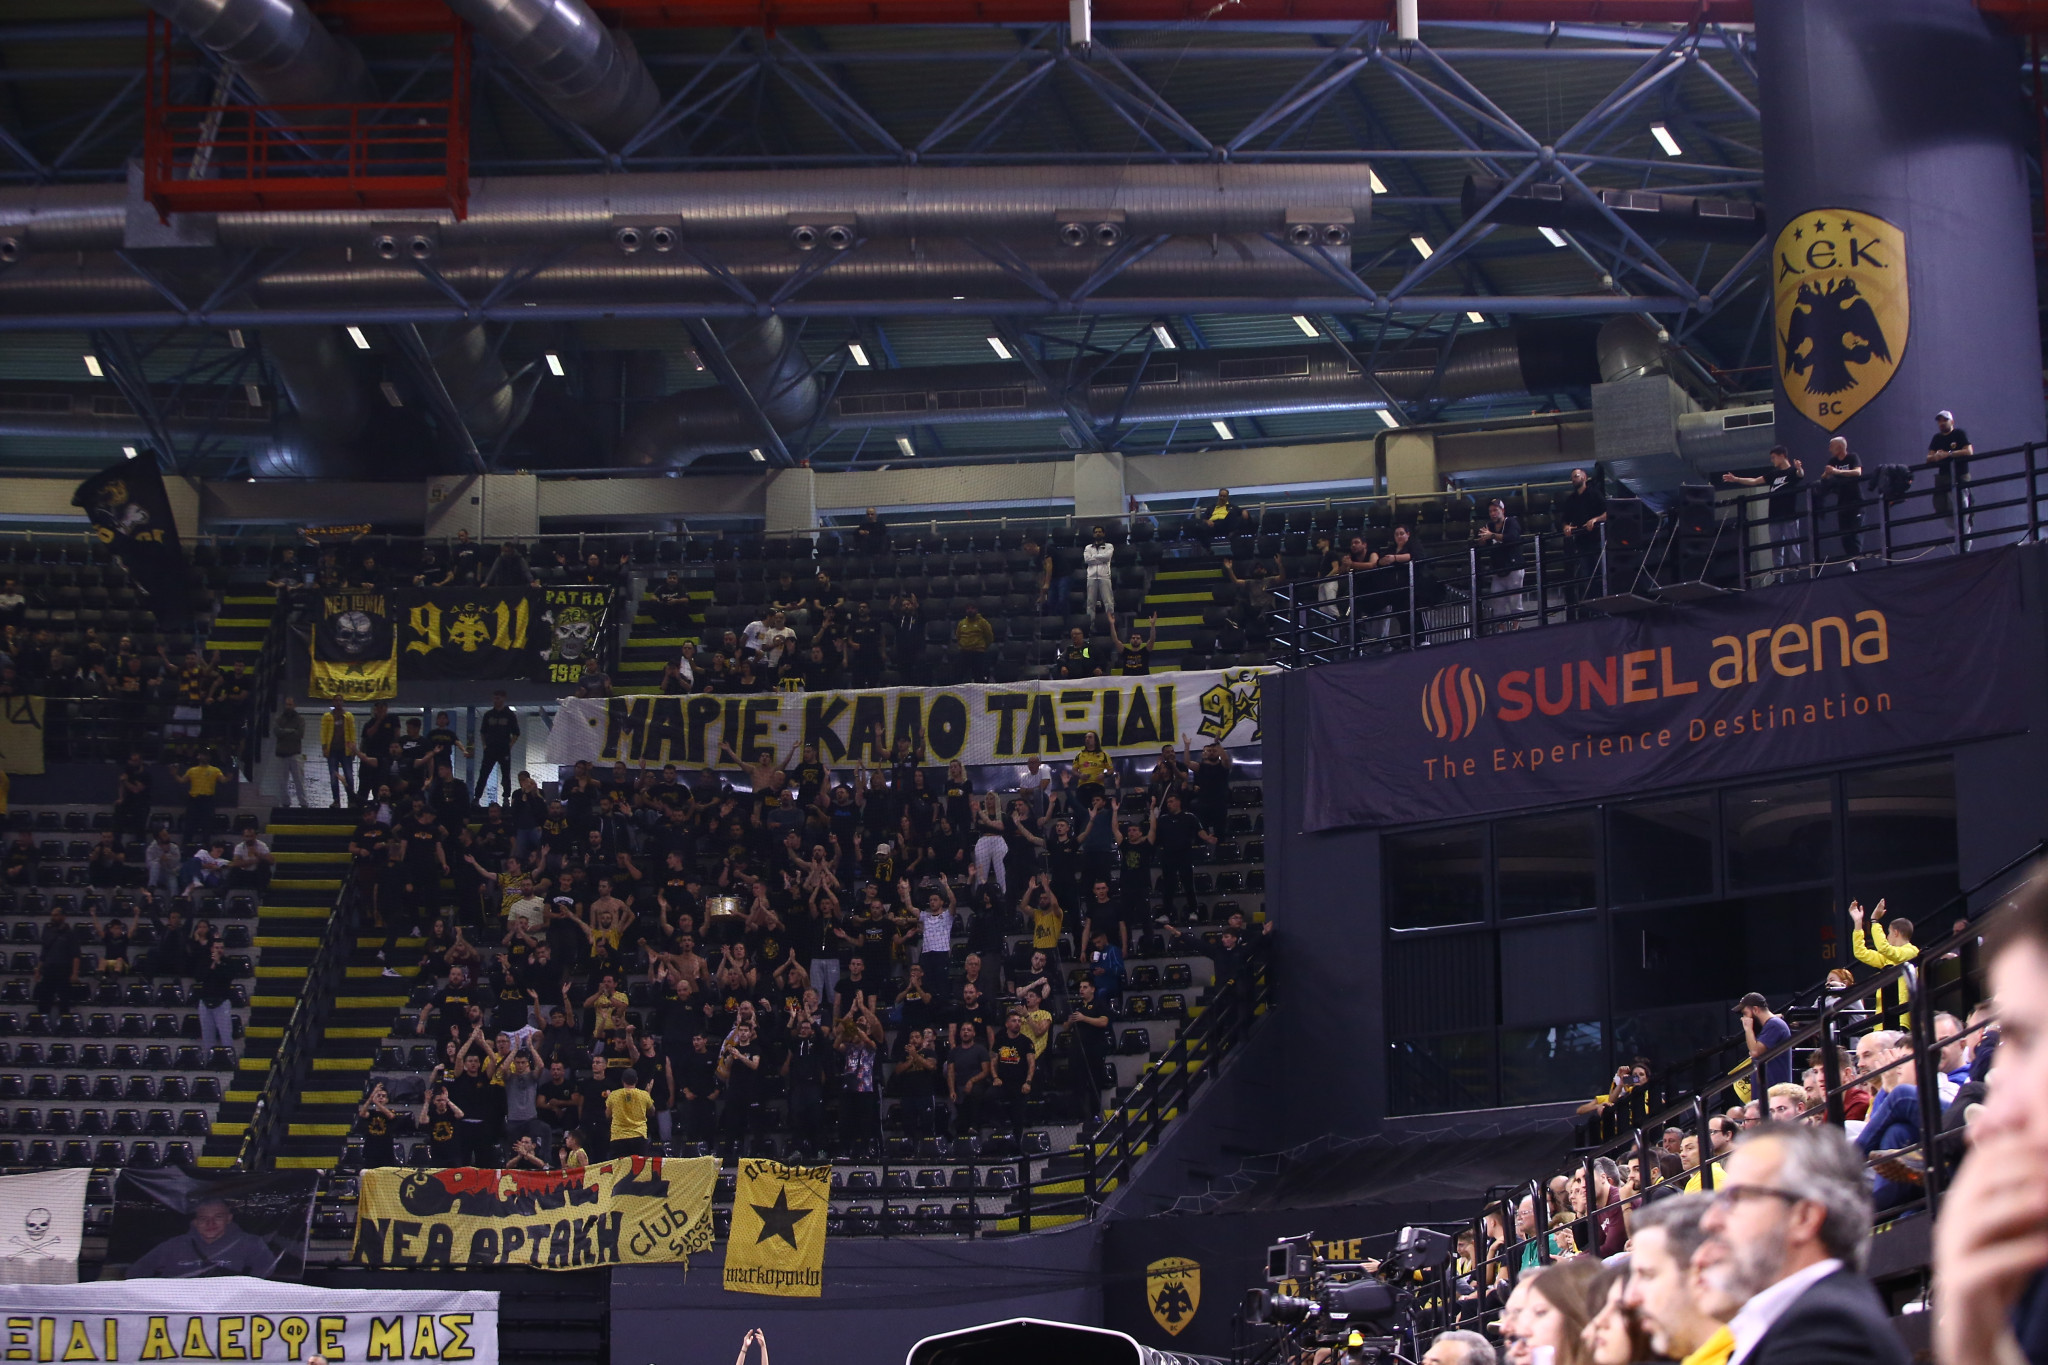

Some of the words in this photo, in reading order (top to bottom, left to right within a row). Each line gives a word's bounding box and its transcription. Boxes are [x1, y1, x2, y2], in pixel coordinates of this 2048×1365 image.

[1818, 401, 1843, 416] BC
[545, 590, 605, 606] PATRA
[548, 664, 587, 683] 198
[1497, 645, 1698, 722] SUNEL
[1708, 609, 1889, 689] arena
[600, 696, 782, 764] ΜΑΡΙΕ
[803, 693, 968, 764] ΚΑΛΟ
[986, 683, 1177, 756] ΤΑΞΙΔΙ
[1424, 756, 1476, 780] The
[1493, 728, 1671, 772] Experience
[1689, 692, 1892, 742] Destination
[352, 1216, 454, 1266] ΝΕΑ
[468, 1211, 623, 1267] ΑΡΤΑΚΗ
[1309, 1239, 1363, 1260] THE
[140, 1315, 346, 1360] ΑΔΕΡΦΕ
[366, 1313, 475, 1359] ΜΑΣ
